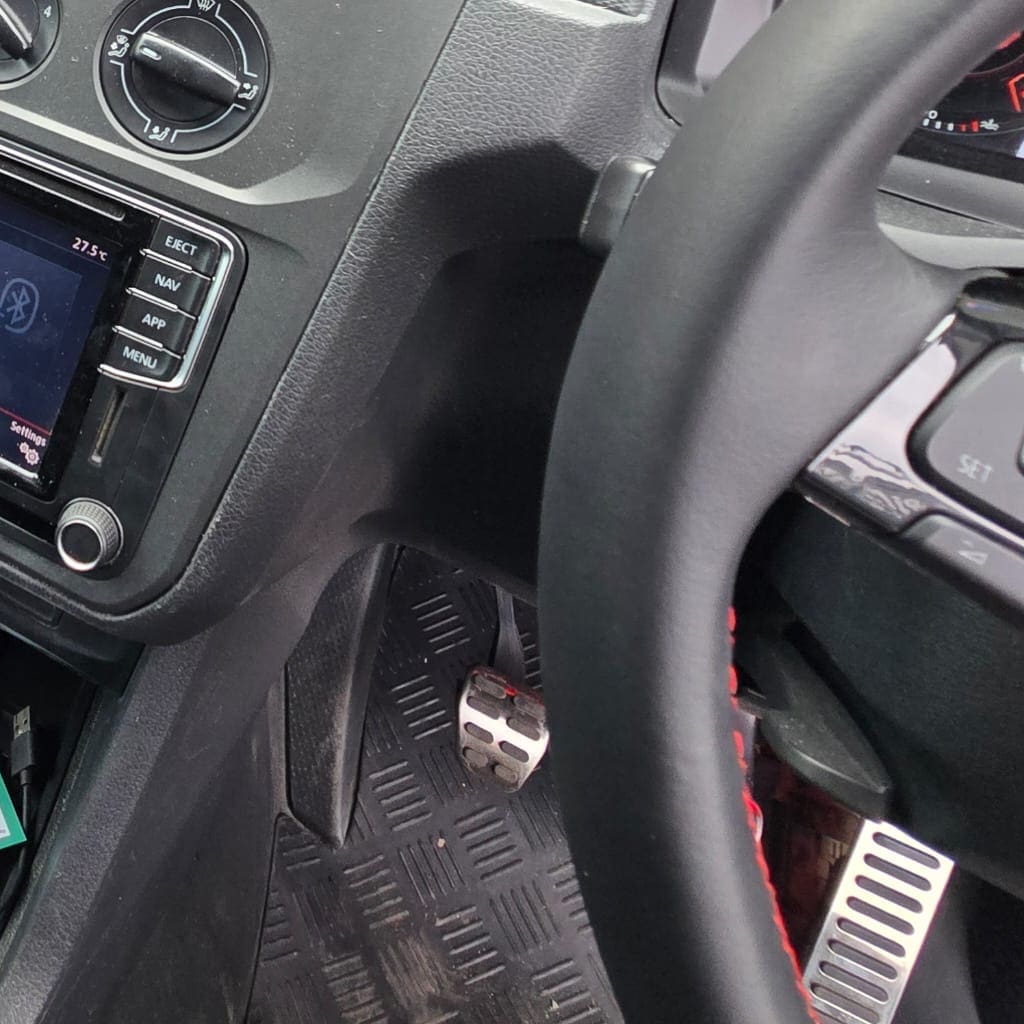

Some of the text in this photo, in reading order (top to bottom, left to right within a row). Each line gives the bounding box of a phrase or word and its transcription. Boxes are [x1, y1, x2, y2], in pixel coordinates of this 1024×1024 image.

[43, 5, 53, 18] 4
[164, 235, 199, 256] EJECT
[153, 273, 182, 293] NAV
[141, 313, 167, 331] APP
[122, 345, 159, 369] MENU
[9, 420, 48, 448] Settings
[956, 454, 993, 484] SET
